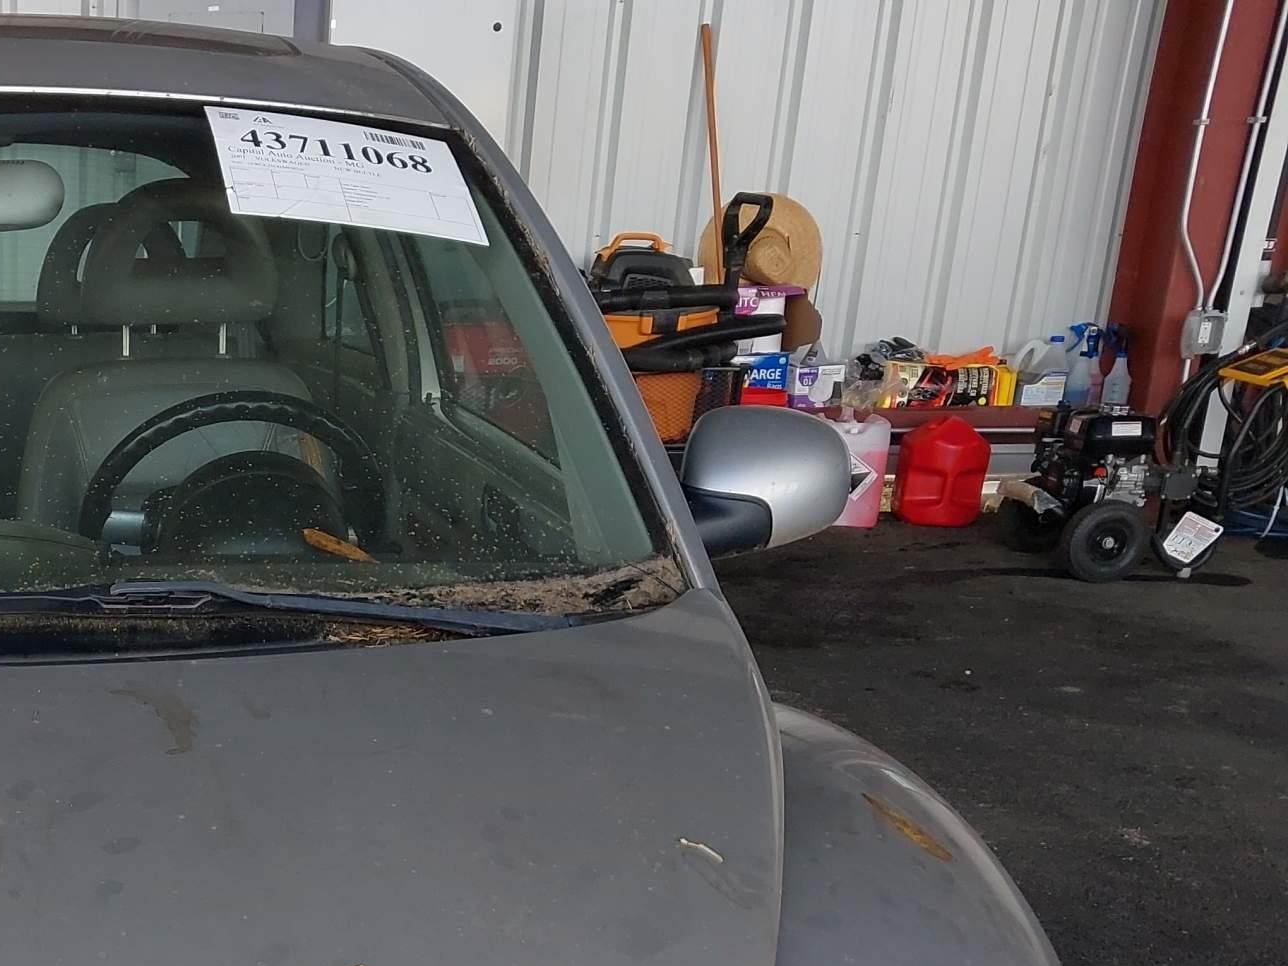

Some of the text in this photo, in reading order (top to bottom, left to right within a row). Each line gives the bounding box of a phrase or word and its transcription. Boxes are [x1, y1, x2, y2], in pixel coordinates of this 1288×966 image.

[228, 145, 265, 157] Capital
[269, 150, 293, 159] Auto
[295, 153, 336, 166] Auction
[240, 129, 433, 174] 43711068
[736, 297, 758, 308] ITC
[748, 367, 783, 380] ARGE
